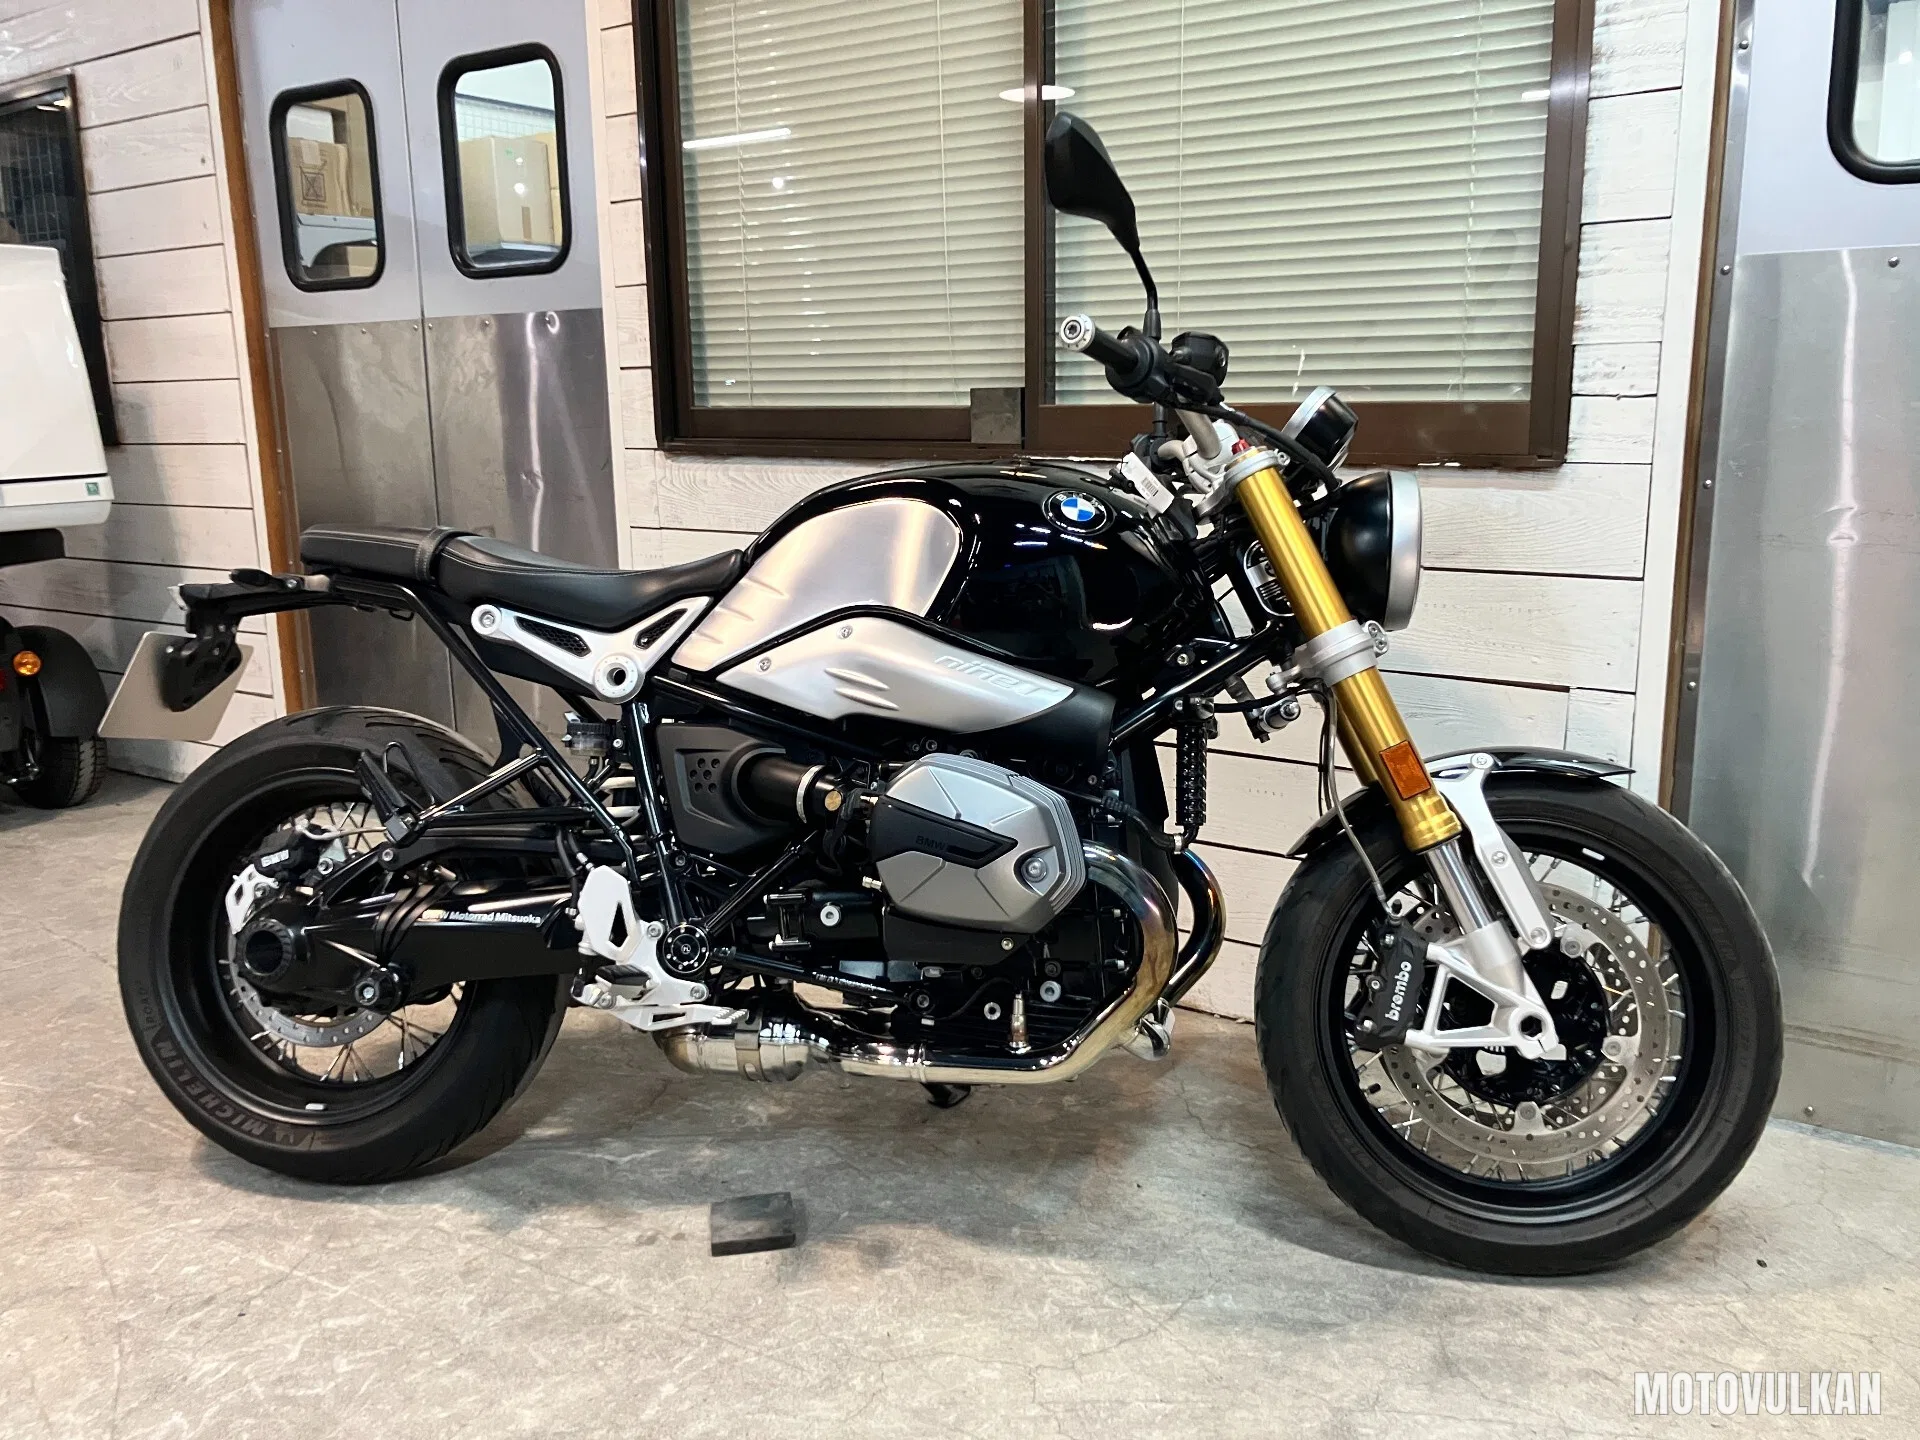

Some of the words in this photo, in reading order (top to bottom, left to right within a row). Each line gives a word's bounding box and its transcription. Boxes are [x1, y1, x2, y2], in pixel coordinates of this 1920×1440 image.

[916, 835, 947, 851] BMW
[449, 911, 495, 922] Motorrad
[495, 912, 541, 924] Mitsuoka
[1384, 961, 1412, 1022] brembo
[155, 1039, 268, 1137] MICHELIN
